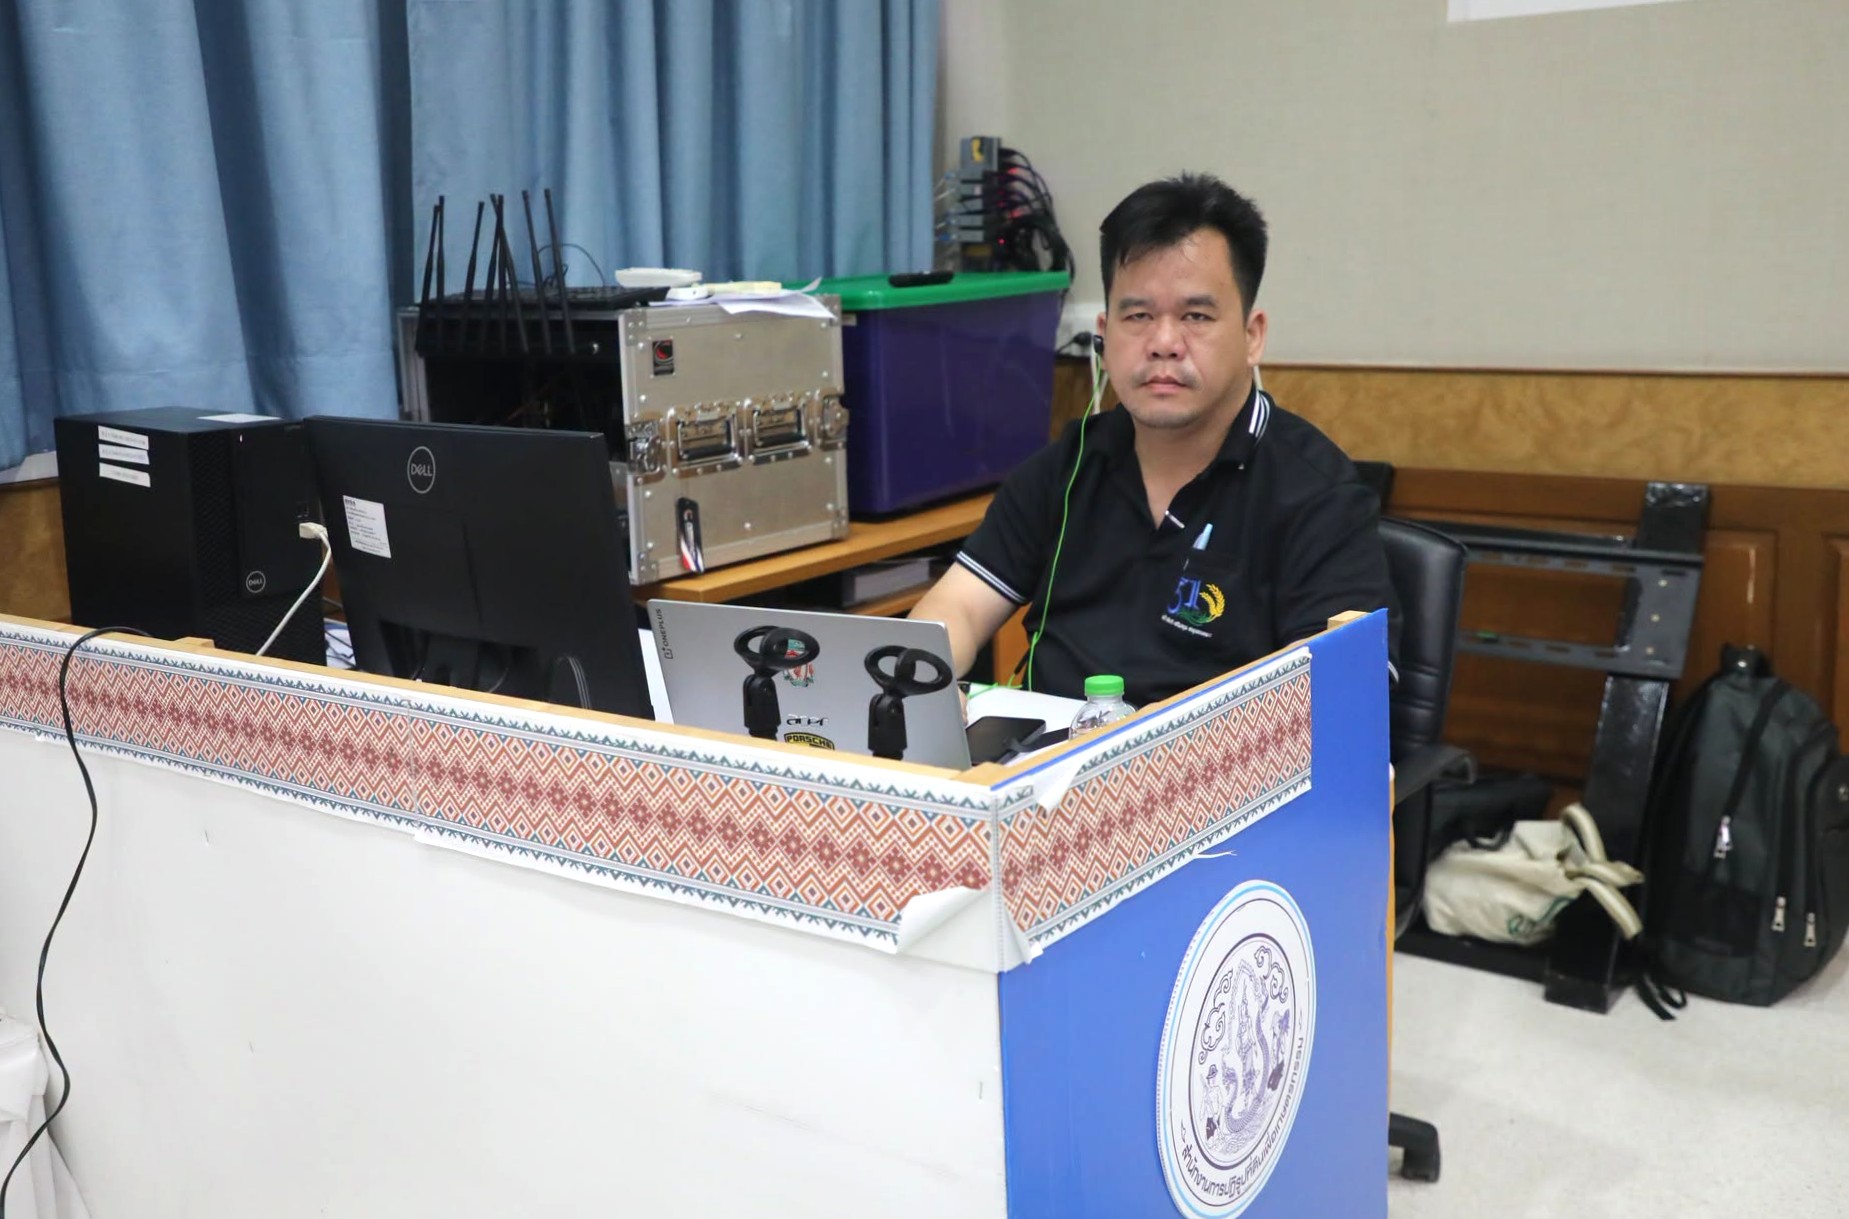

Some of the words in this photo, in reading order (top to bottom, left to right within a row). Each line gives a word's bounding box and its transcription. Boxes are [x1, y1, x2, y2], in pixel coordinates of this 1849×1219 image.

[411, 463, 433, 477] DELL
[248, 578, 263, 586] DELL
[1167, 577, 1202, 614] 51
[655, 608, 669, 648] ONEPLUS
[786, 735, 832, 749] PORSCHE
[1181, 1037, 1304, 1199] สำนักงานการปฏิรูปที่ดินเพื่อเกษตรกรรม
